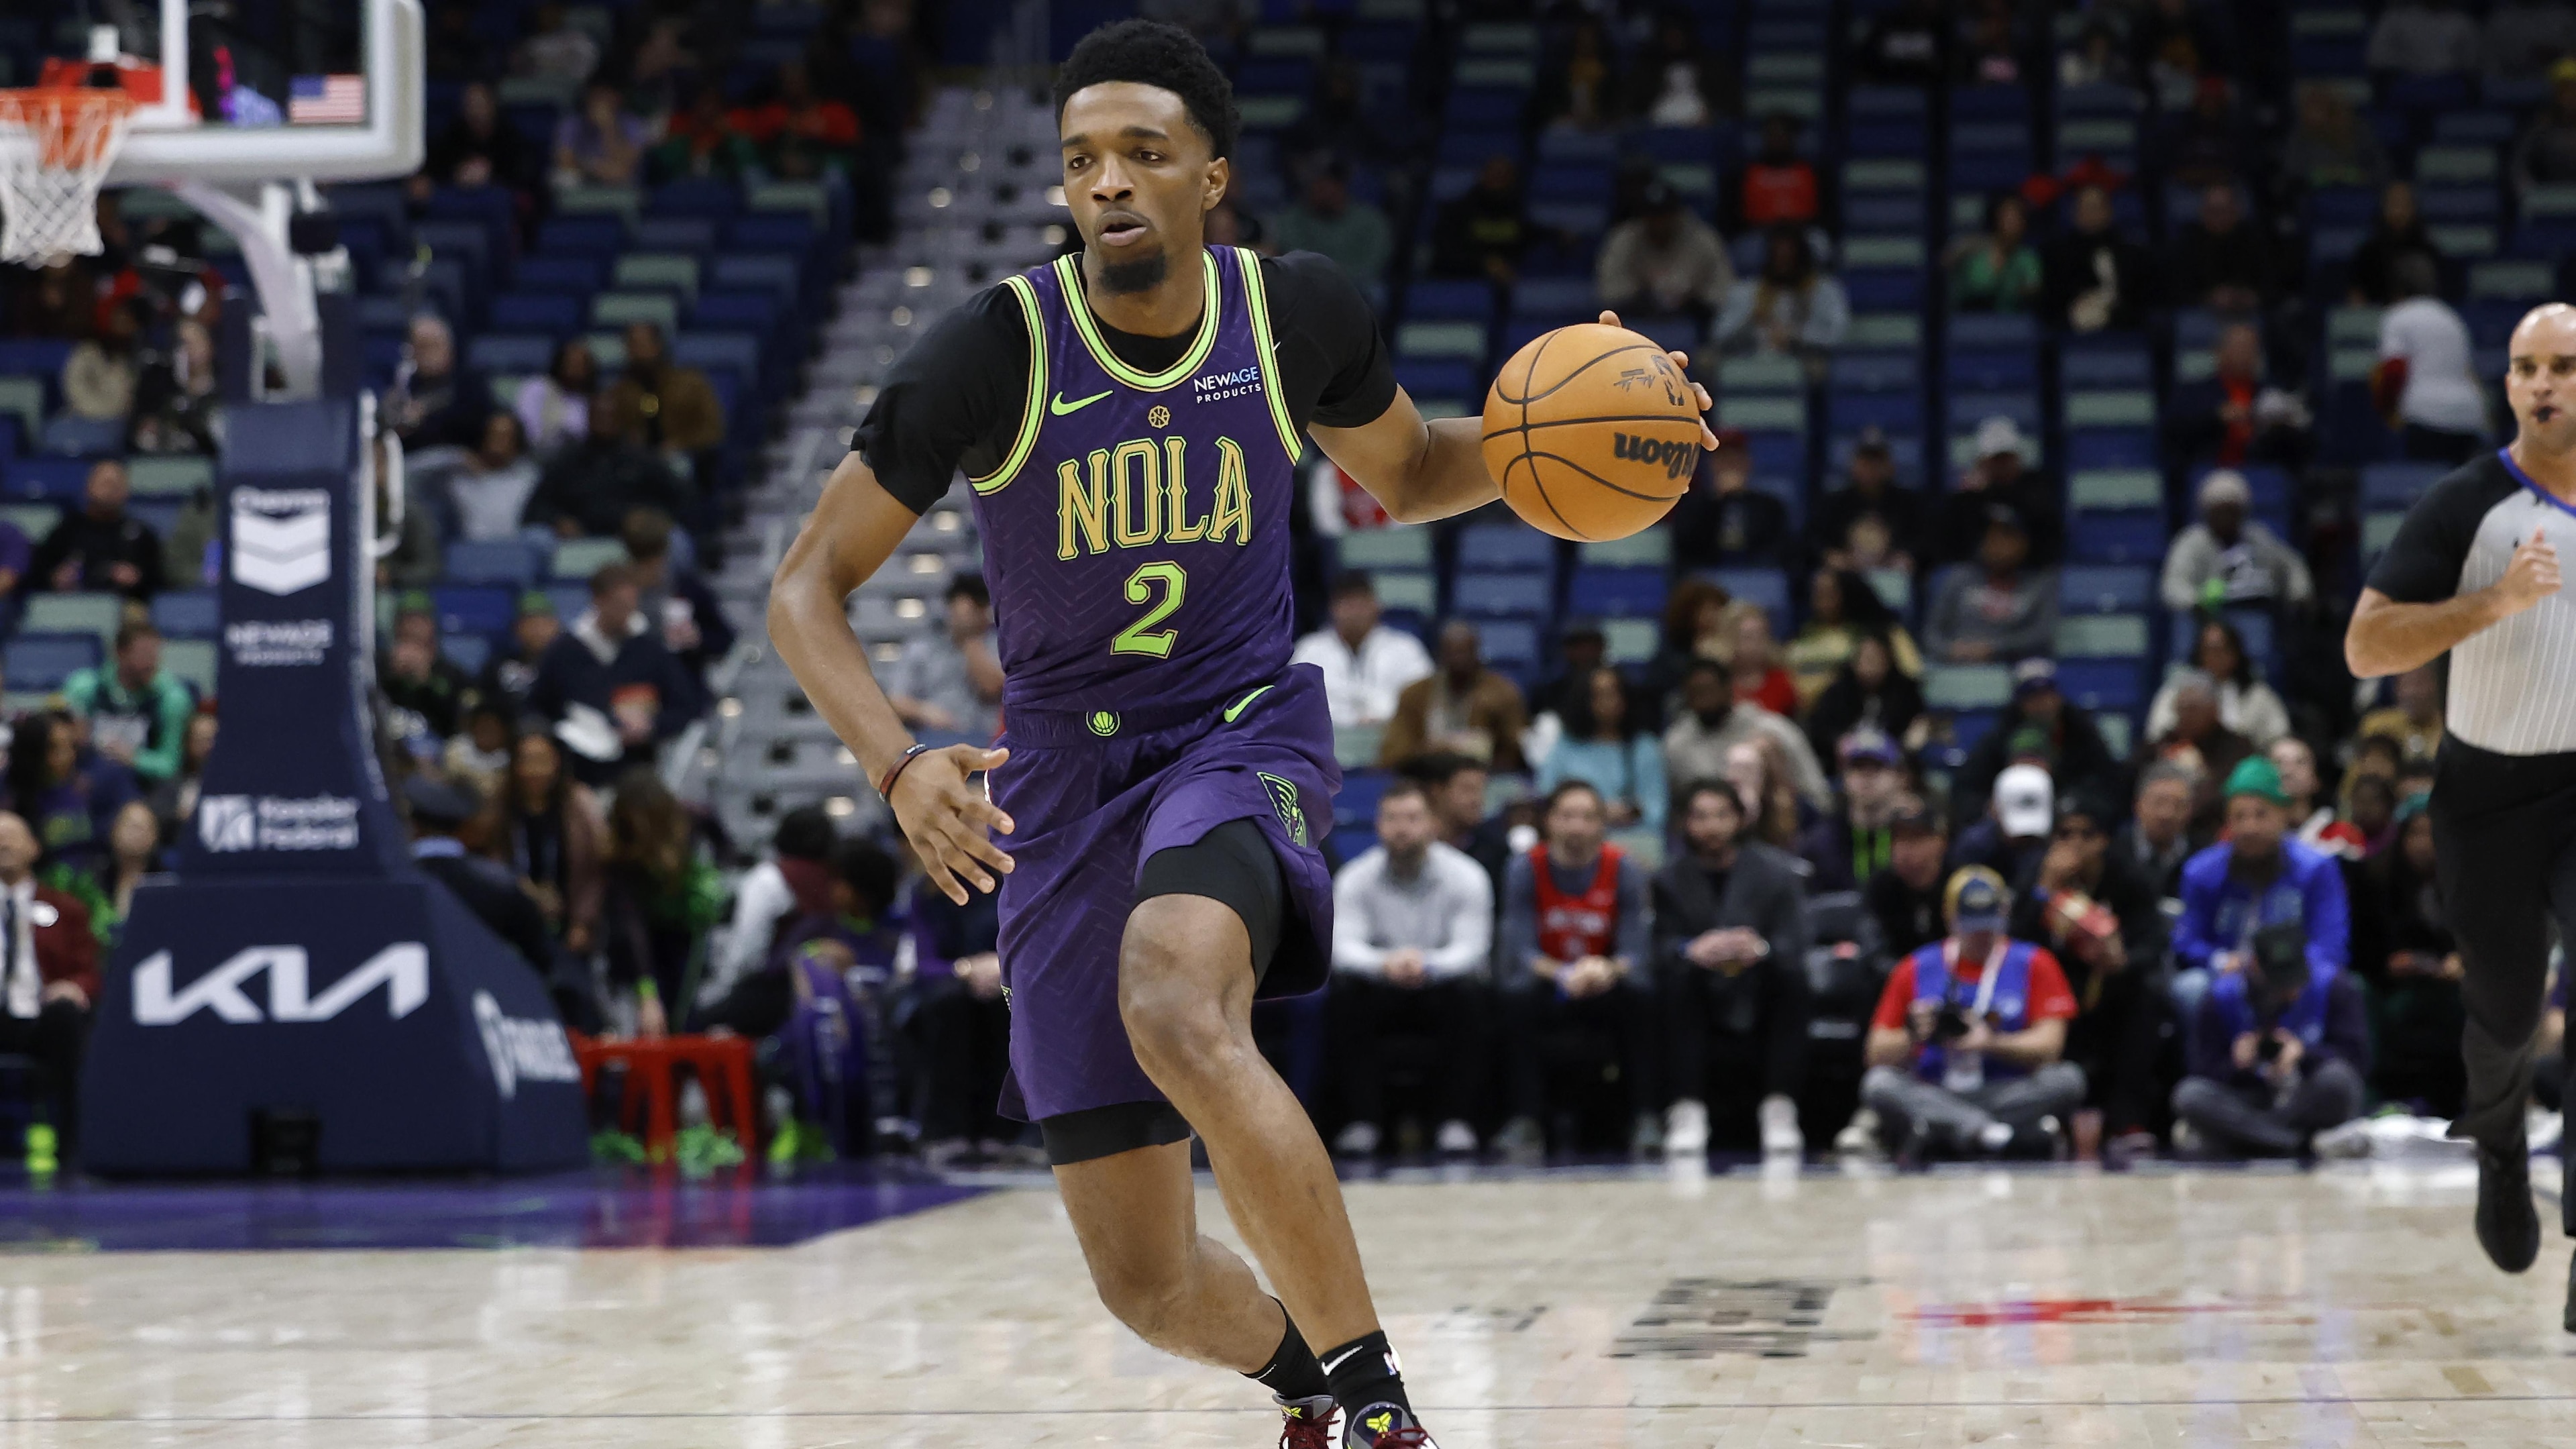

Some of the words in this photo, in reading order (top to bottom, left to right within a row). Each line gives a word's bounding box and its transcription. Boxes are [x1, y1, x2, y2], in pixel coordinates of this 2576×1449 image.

[1193, 366, 1260, 392] NEWAGE
[1196, 383, 1262, 404] PRODUCTS
[1057, 436, 1251, 561] NOLA
[1110, 560, 1187, 659] 2
[132, 941, 429, 1025] KIA
